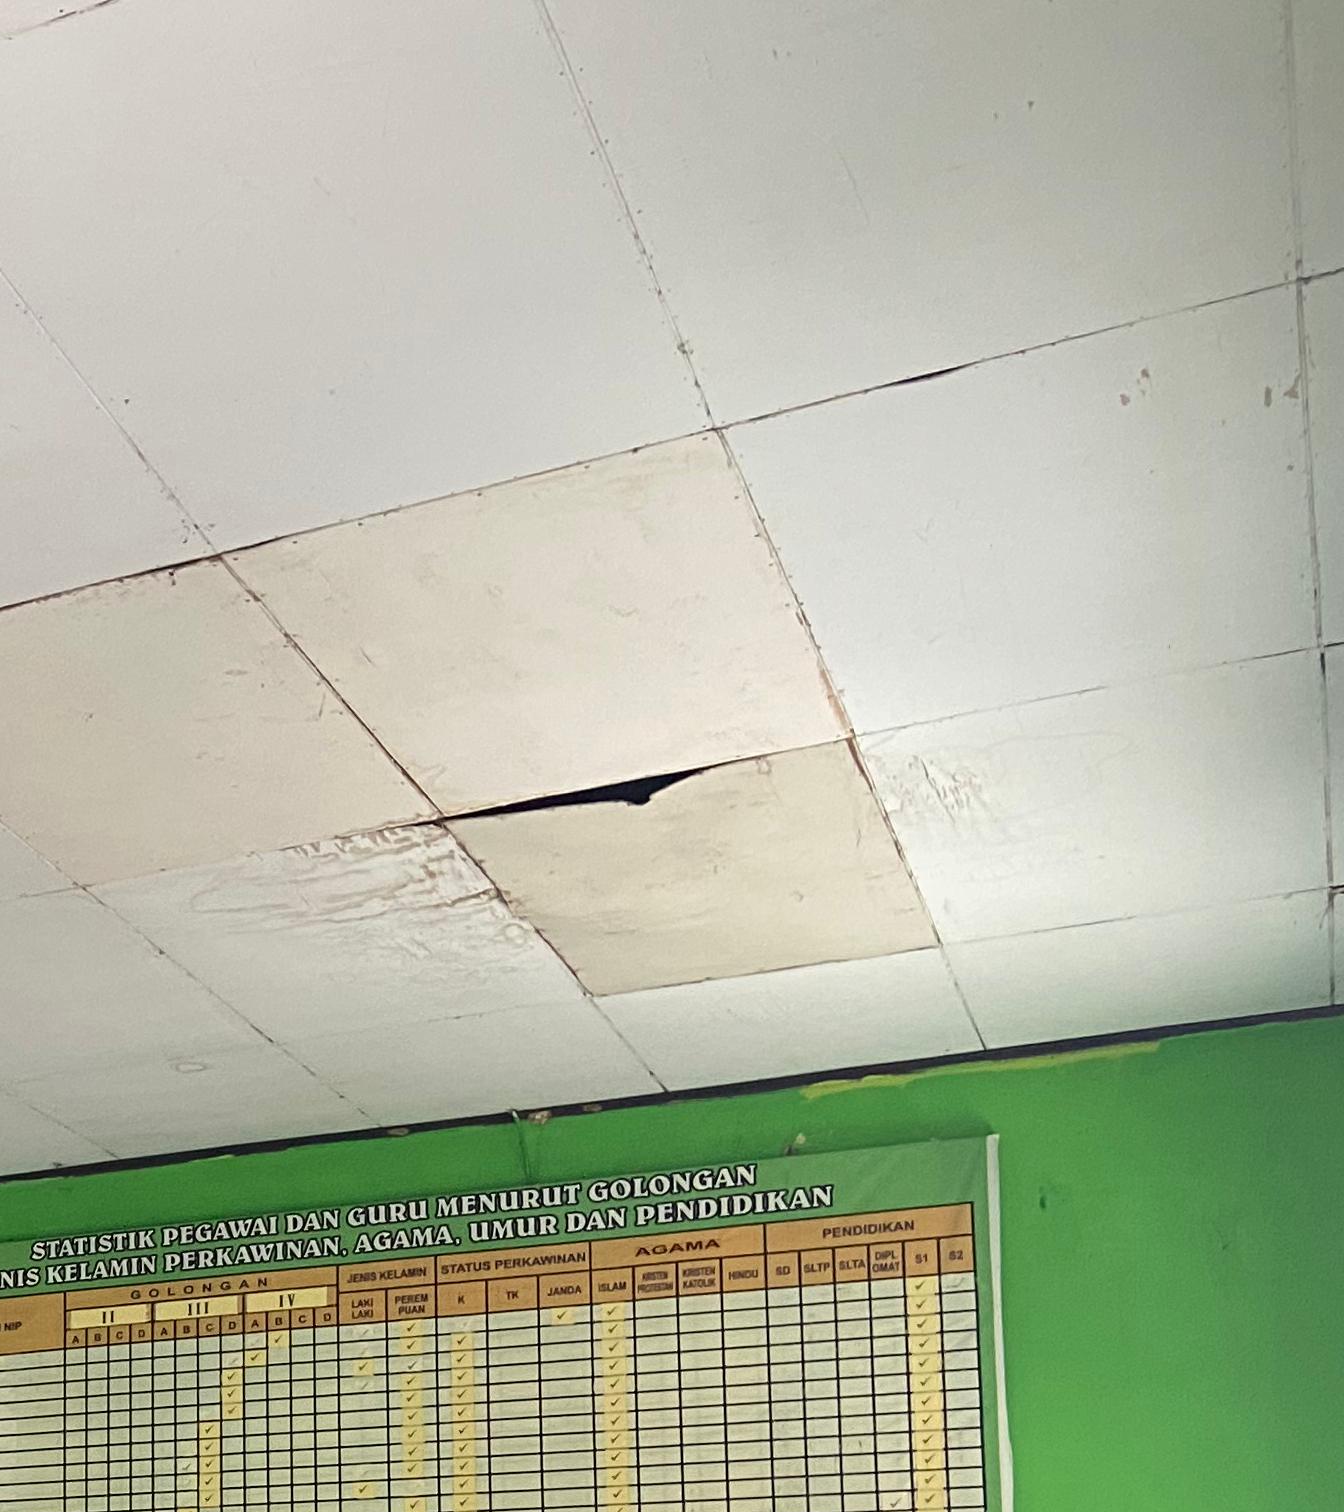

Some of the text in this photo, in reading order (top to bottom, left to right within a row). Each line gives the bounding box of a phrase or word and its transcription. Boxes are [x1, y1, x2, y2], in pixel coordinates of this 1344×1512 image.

[30, 1163, 758, 1261] STATISTIK PEGAWAI DAN GURU MENURUT GOLONGAN
[822, 1220, 915, 1239] PENDIDIKAN
[46, 1255, 157, 1286] KELAMIN
[164, 1235, 348, 1273] PERKAWINAN,
[354, 1227, 461, 1254] AGAMA,
[468, 1207, 559, 1242] UMUR
[565, 1202, 627, 1232] DAN
[634, 1185, 834, 1228] PENDIDIKAN
[635, 1239, 721, 1258] AGAMA
[915, 1254, 928, 1264] S1
[948, 1250, 964, 1260] S2
[440, 1252, 587, 1275] STATUS PERKAWINAN
[803, 1262, 830, 1273] SLTP
[839, 1259, 866, 1270] SLTA
[347, 1267, 427, 1284] JENIS KELAMIN
[728, 1269, 759, 1280] HINDU
[775, 1265, 791, 1276] SD
[130, 1277, 268, 1300] GOLONGAN
[547, 1285, 582, 1297] JANDA
[598, 1282, 627, 1292] ISLAM
[457, 1296, 466, 1305] K
[506, 1290, 519, 1300] TK
[279, 1294, 295, 1308] IV
[351, 1298, 374, 1308] LAKI
[187, 1301, 209, 1316] III
[351, 1309, 374, 1319] LAKI
[398, 1305, 425, 1315] PUAN
[102, 1310, 115, 1324] II
[4, 1321, 22, 1332] NIP
